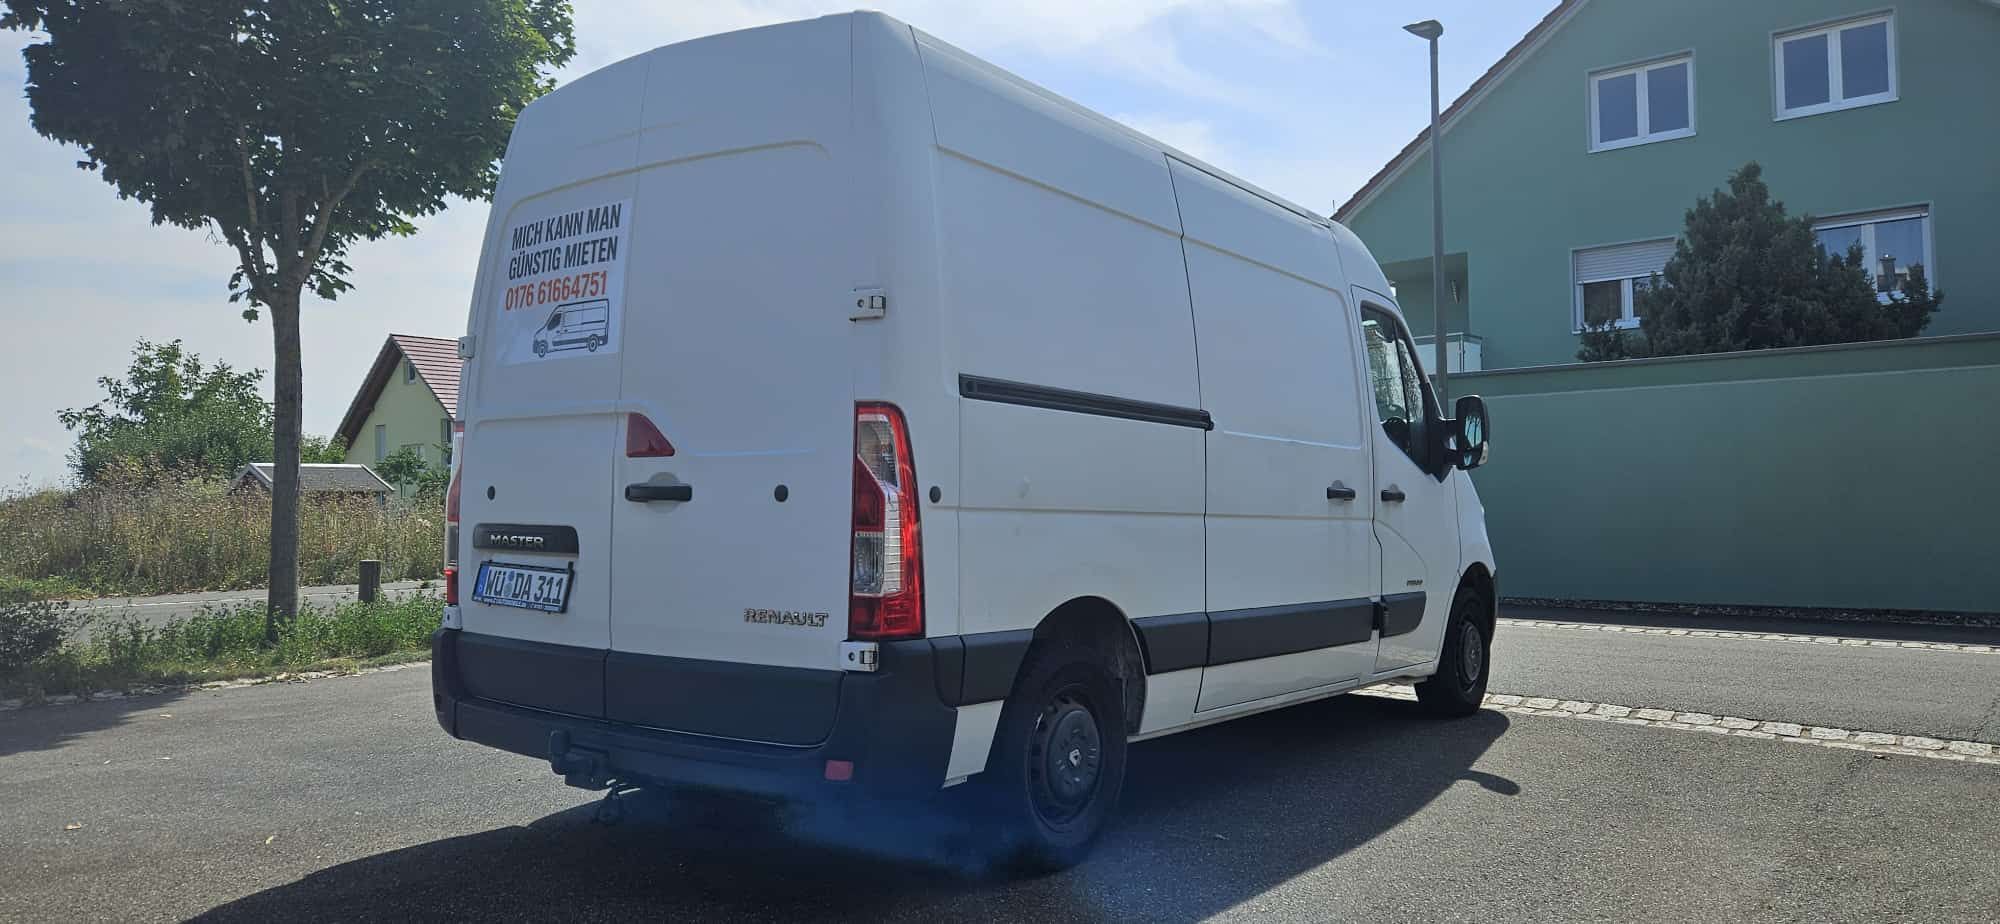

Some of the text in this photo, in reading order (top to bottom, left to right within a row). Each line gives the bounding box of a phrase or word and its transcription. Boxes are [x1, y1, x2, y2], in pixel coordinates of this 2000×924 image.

[512, 203, 622, 251] MICH KANN MAN
[508, 235, 618, 280] GÜNSTIG MIETEN
[505, 270, 607, 311] 0176 61664751
[490, 534, 545, 548] MASTER
[511, 572, 533, 600] DA
[533, 575, 563, 604] 311
[743, 607, 829, 627] RENAULT
